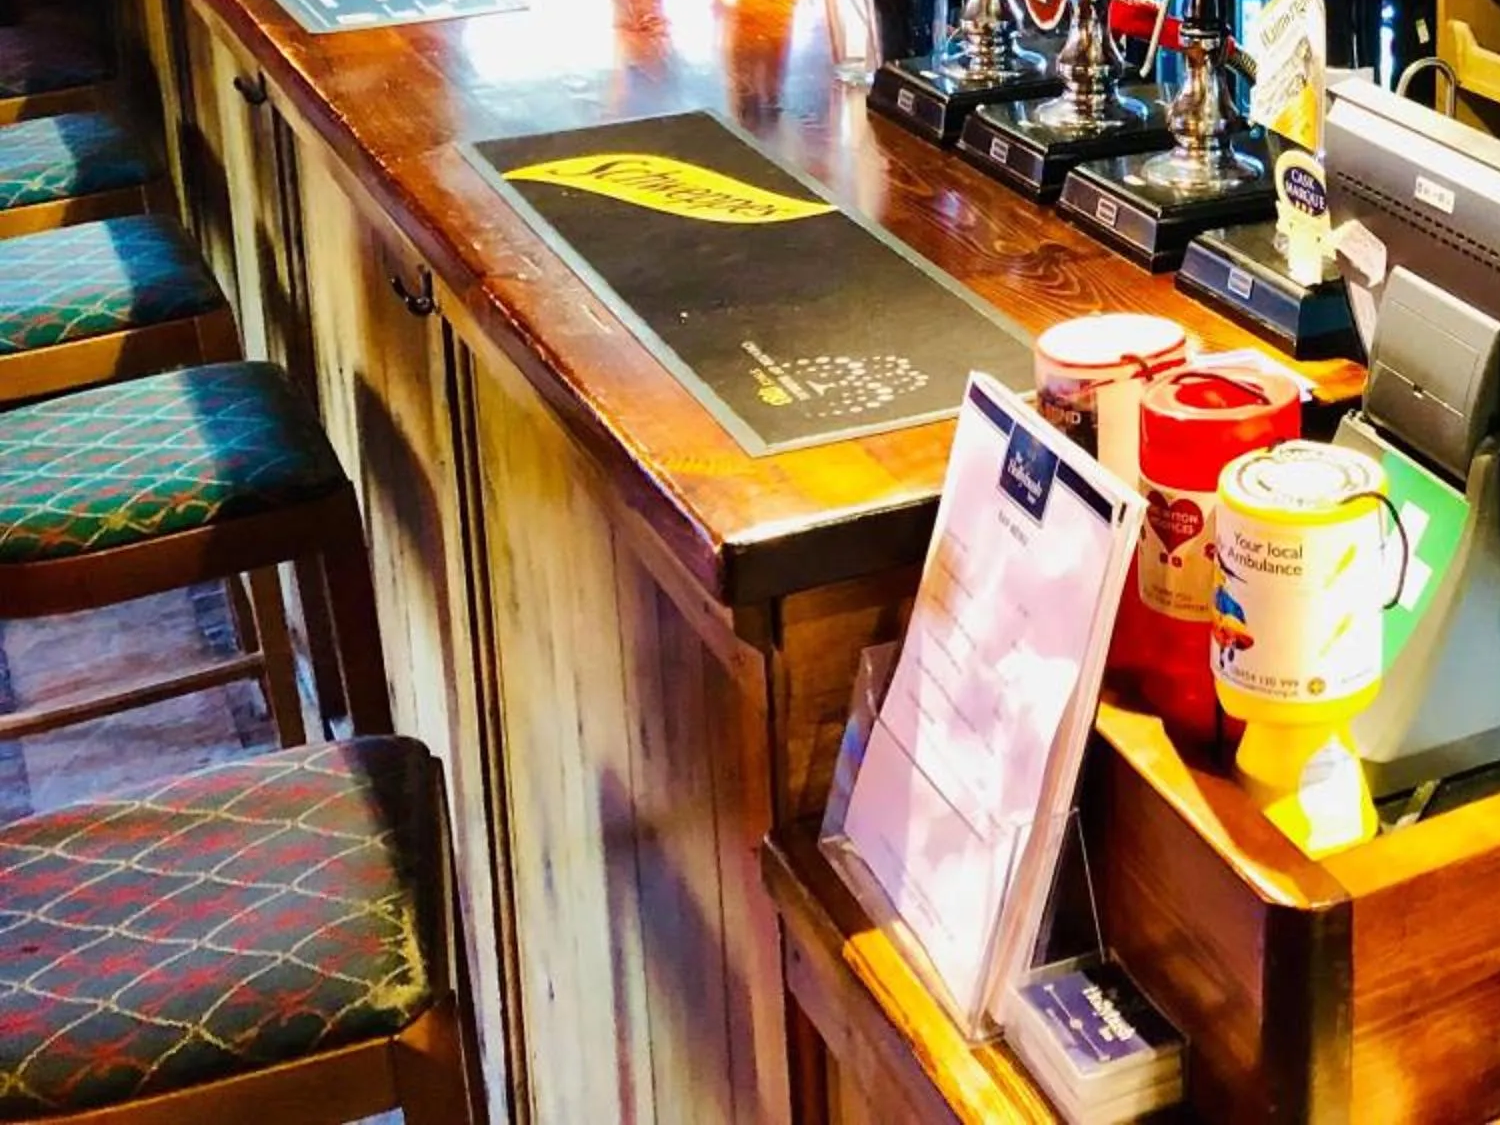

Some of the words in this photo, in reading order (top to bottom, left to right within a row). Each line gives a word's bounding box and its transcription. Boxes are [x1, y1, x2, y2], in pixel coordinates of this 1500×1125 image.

[552, 157, 785, 218] Schweppes
[1290, 168, 1315, 190] CASK
[1233, 530, 1263, 554] Your
[1267, 541, 1304, 561] local
[1227, 547, 1304, 577] Ambulance
